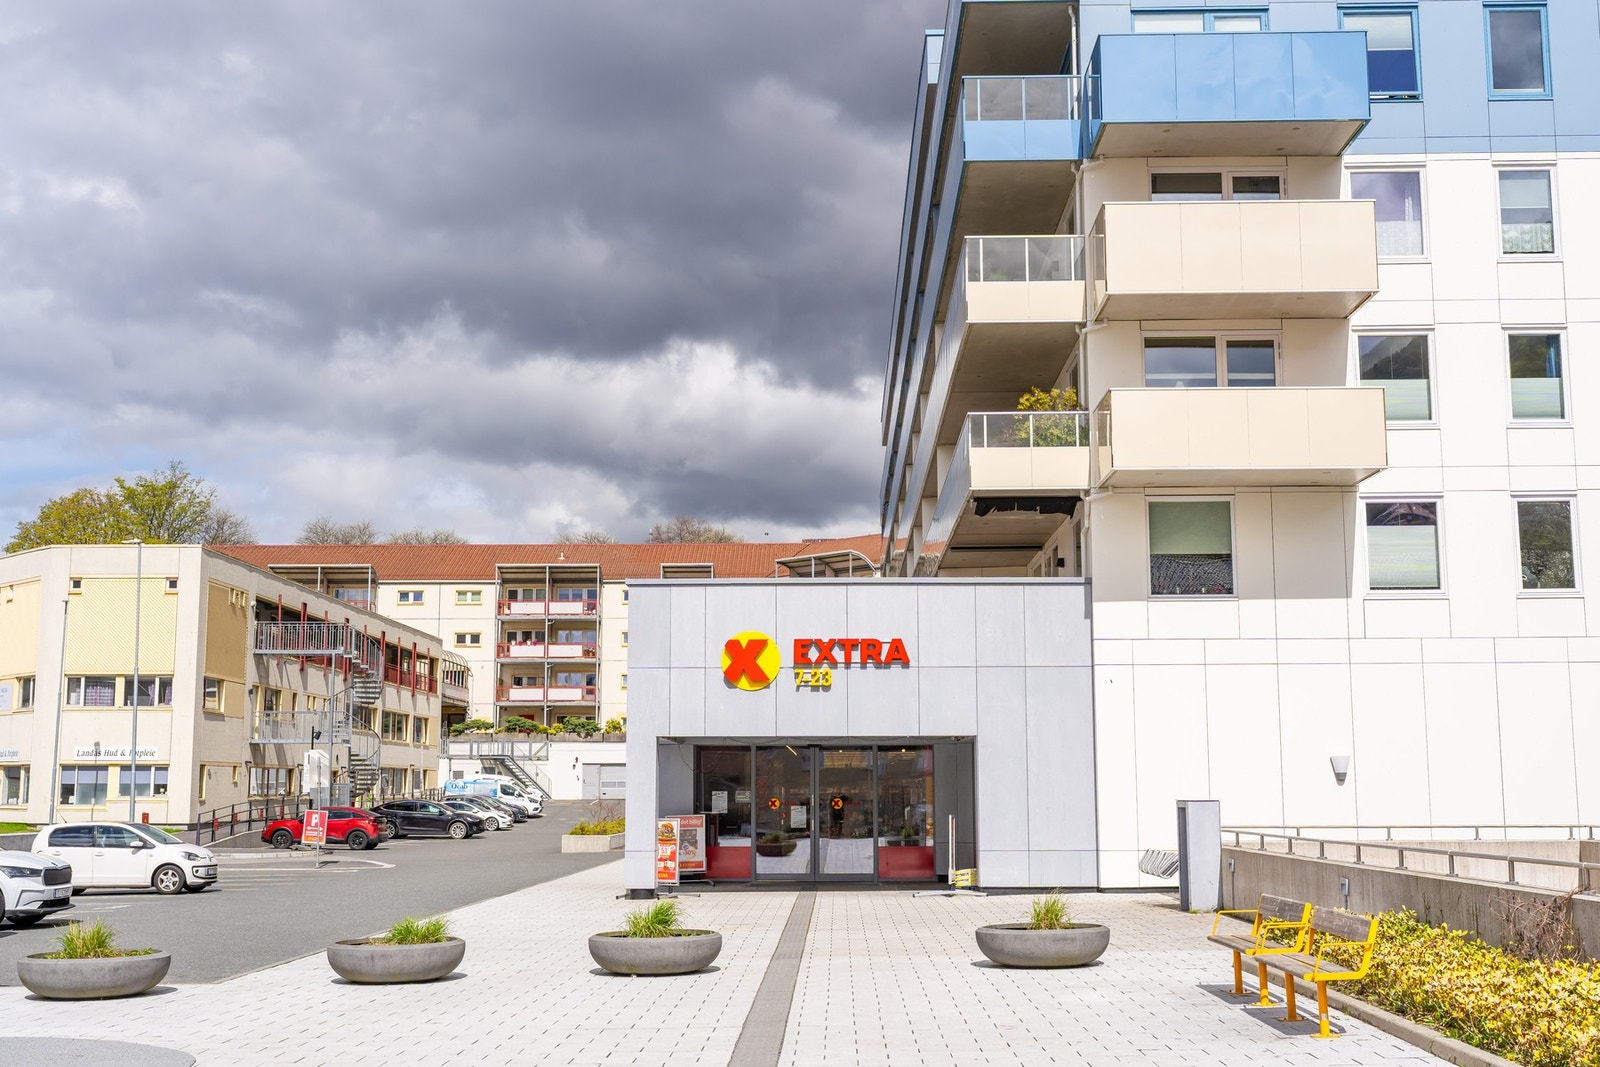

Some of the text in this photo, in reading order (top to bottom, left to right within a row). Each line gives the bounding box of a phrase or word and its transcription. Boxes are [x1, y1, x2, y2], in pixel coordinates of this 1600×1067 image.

[793, 638, 911, 664] EXTRA
[794, 668, 833, 687] 7-23
[103, 748, 119, 757] Hud
[119, 749, 127, 757] &
